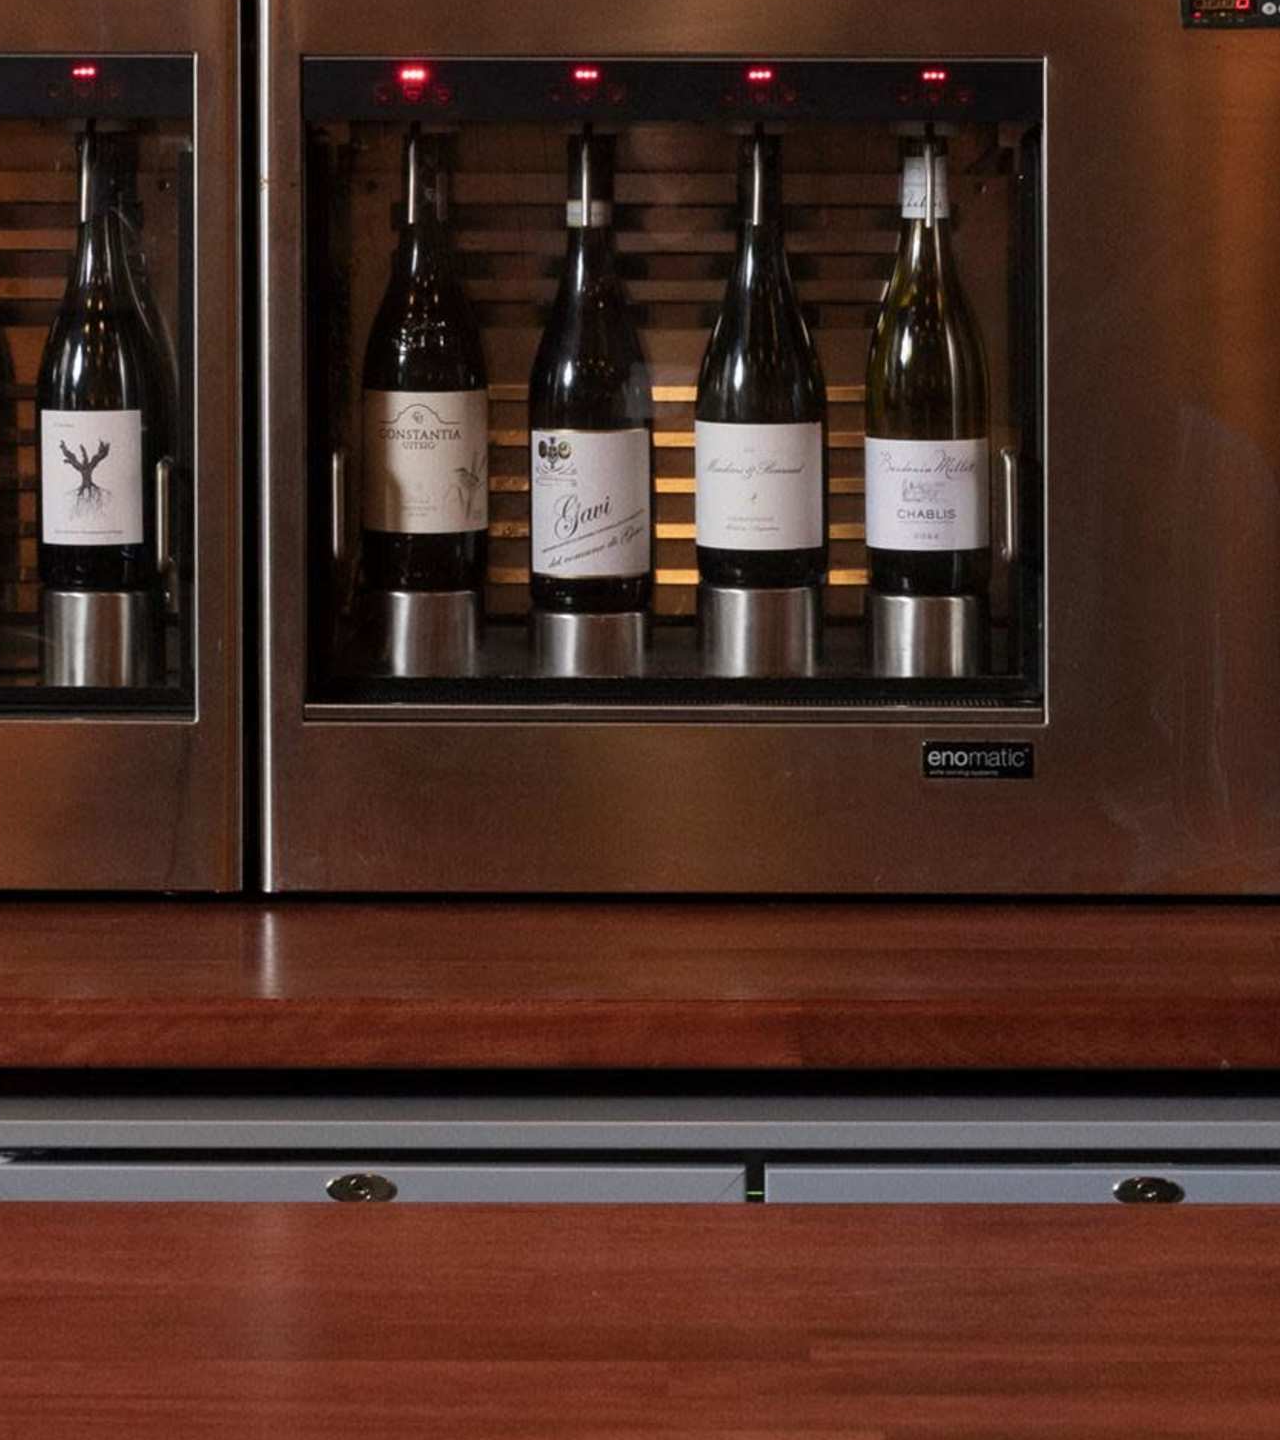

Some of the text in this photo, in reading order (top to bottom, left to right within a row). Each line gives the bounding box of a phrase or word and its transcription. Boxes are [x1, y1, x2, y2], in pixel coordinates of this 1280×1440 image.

[381, 428, 462, 441] CONSTANTIA
[553, 492, 611, 541] Gavi
[896, 507, 958, 521] CHABLIS
[927, 748, 1026, 768] enomatic
